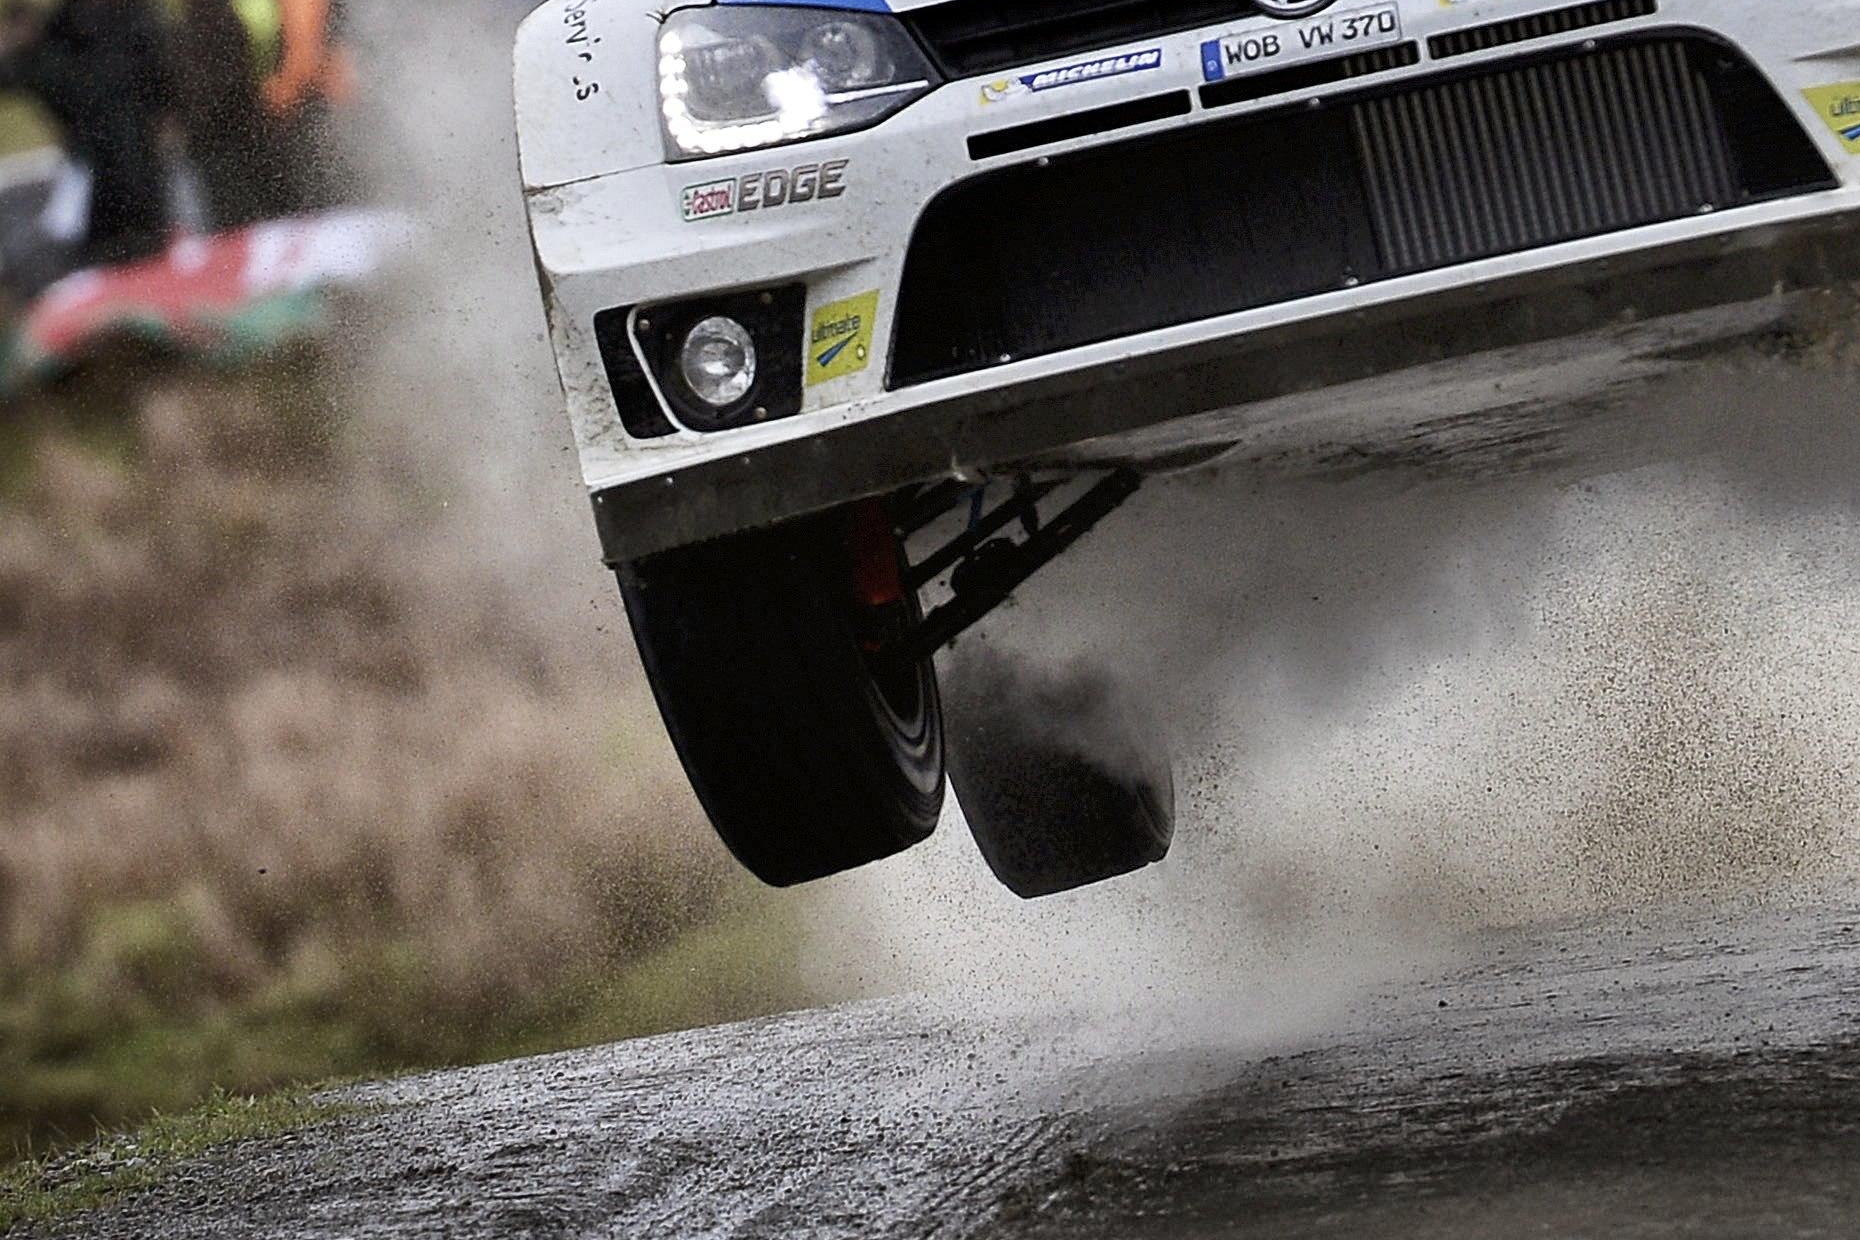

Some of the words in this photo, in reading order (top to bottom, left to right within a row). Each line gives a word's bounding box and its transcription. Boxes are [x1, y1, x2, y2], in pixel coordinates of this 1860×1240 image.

[1225, 34, 1281, 64] WOB
[1299, 22, 1333, 49] VW
[1342, 11, 1396, 40] 370
[1032, 51, 1159, 88] MICHELIN
[692, 184, 732, 216] Castrol
[737, 159, 850, 213] EDGE
